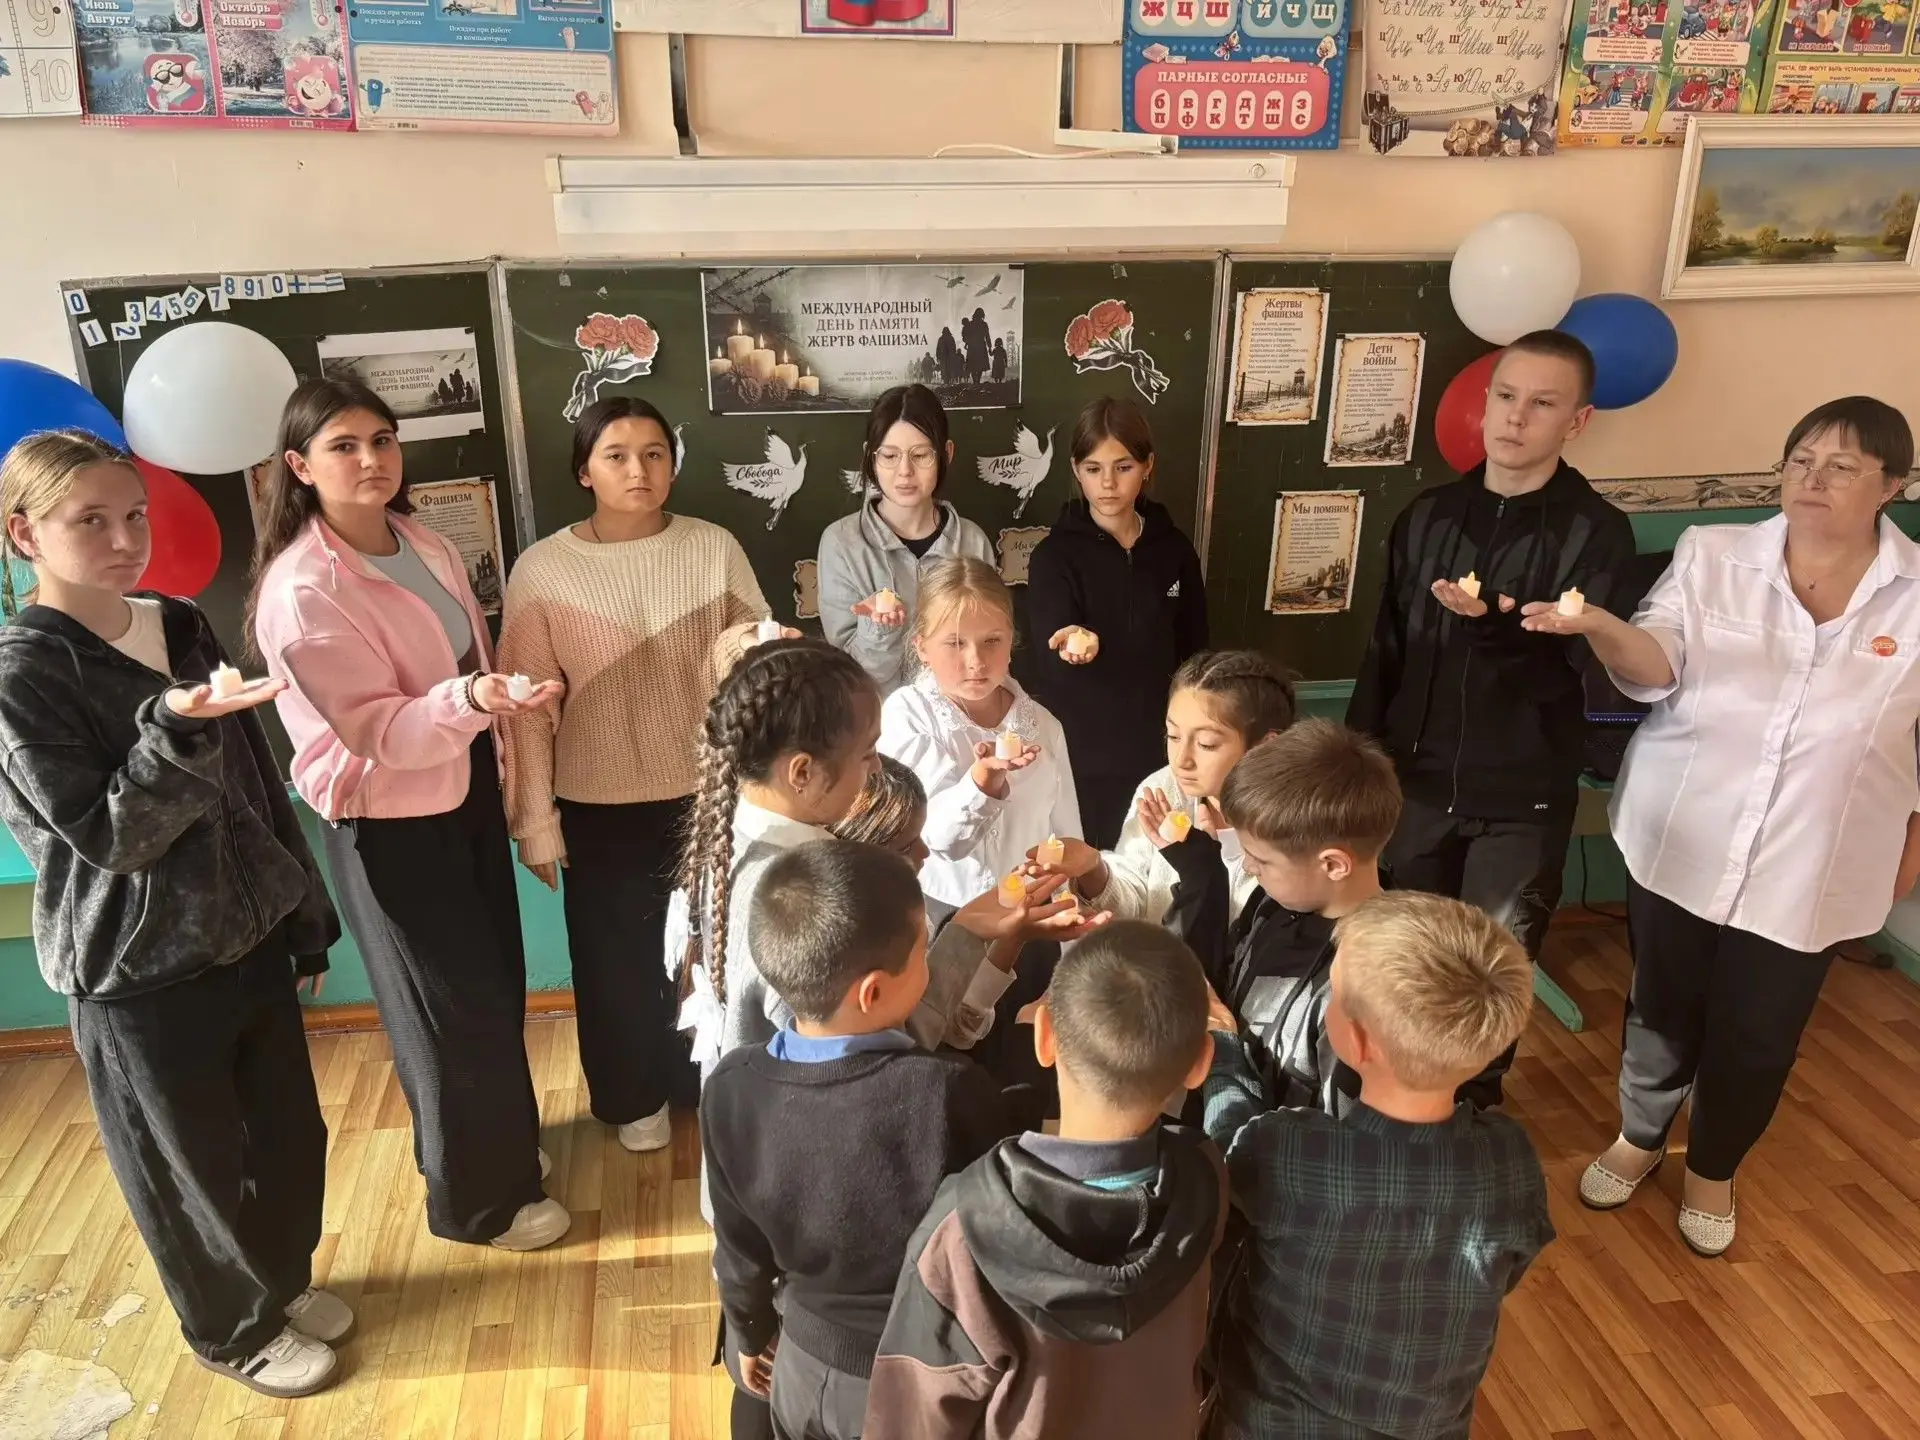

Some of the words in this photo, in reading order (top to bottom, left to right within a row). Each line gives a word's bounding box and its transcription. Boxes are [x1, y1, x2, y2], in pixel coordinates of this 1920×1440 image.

[220, 1, 271, 14] Октябрь
[87, 13, 130, 26] Август
[222, 16, 266, 29] Ноябрь
[30, 59, 74, 102] 10
[1157, 71, 1219, 83] ПАРНЫЕ
[1221, 72, 1309, 84] СОГЛАСНЫЕ
[71, 293, 85, 312] 0
[86, 323, 99, 343] 1
[116, 325, 137, 337] 2
[130, 303, 141, 323] 3
[149, 300, 163, 320] 4
[170, 297, 183, 316] 5
[184, 292, 197, 309] 6
[210, 289, 221, 309] 7
[225, 276, 236, 295] 8
[244, 278, 255, 297] 9
[800, 298, 932, 316] МЕЖДУНАРОДНЫЙ
[1264, 298, 1303, 311] Жертвы
[1261, 308, 1304, 320] фашизма
[816, 318, 855, 333] ДЕНЬ
[859, 317, 920, 331] ПАМЯТИ
[807, 334, 855, 348] ЖЕРТВ
[858, 333, 929, 347] ФАШИЗМА
[1367, 343, 1393, 355] Дети
[1362, 354, 1397, 366] войны
[370, 366, 435, 378] МЕЖДУНАРОДНЫЙ
[379, 376, 398, 385] ДЕНЬ
[399, 375, 430, 384] ПАМЯТИ
[375, 383, 399, 392] ЖЕРТВ
[399, 382, 435, 391] ФАШИЗМА
[989, 457, 1021, 473] Мир
[736, 465, 783, 480] Свобода
[420, 493, 473, 507] Фашизм
[1292, 503, 1311, 514] Мы
[1313, 504, 1350, 515] помним
